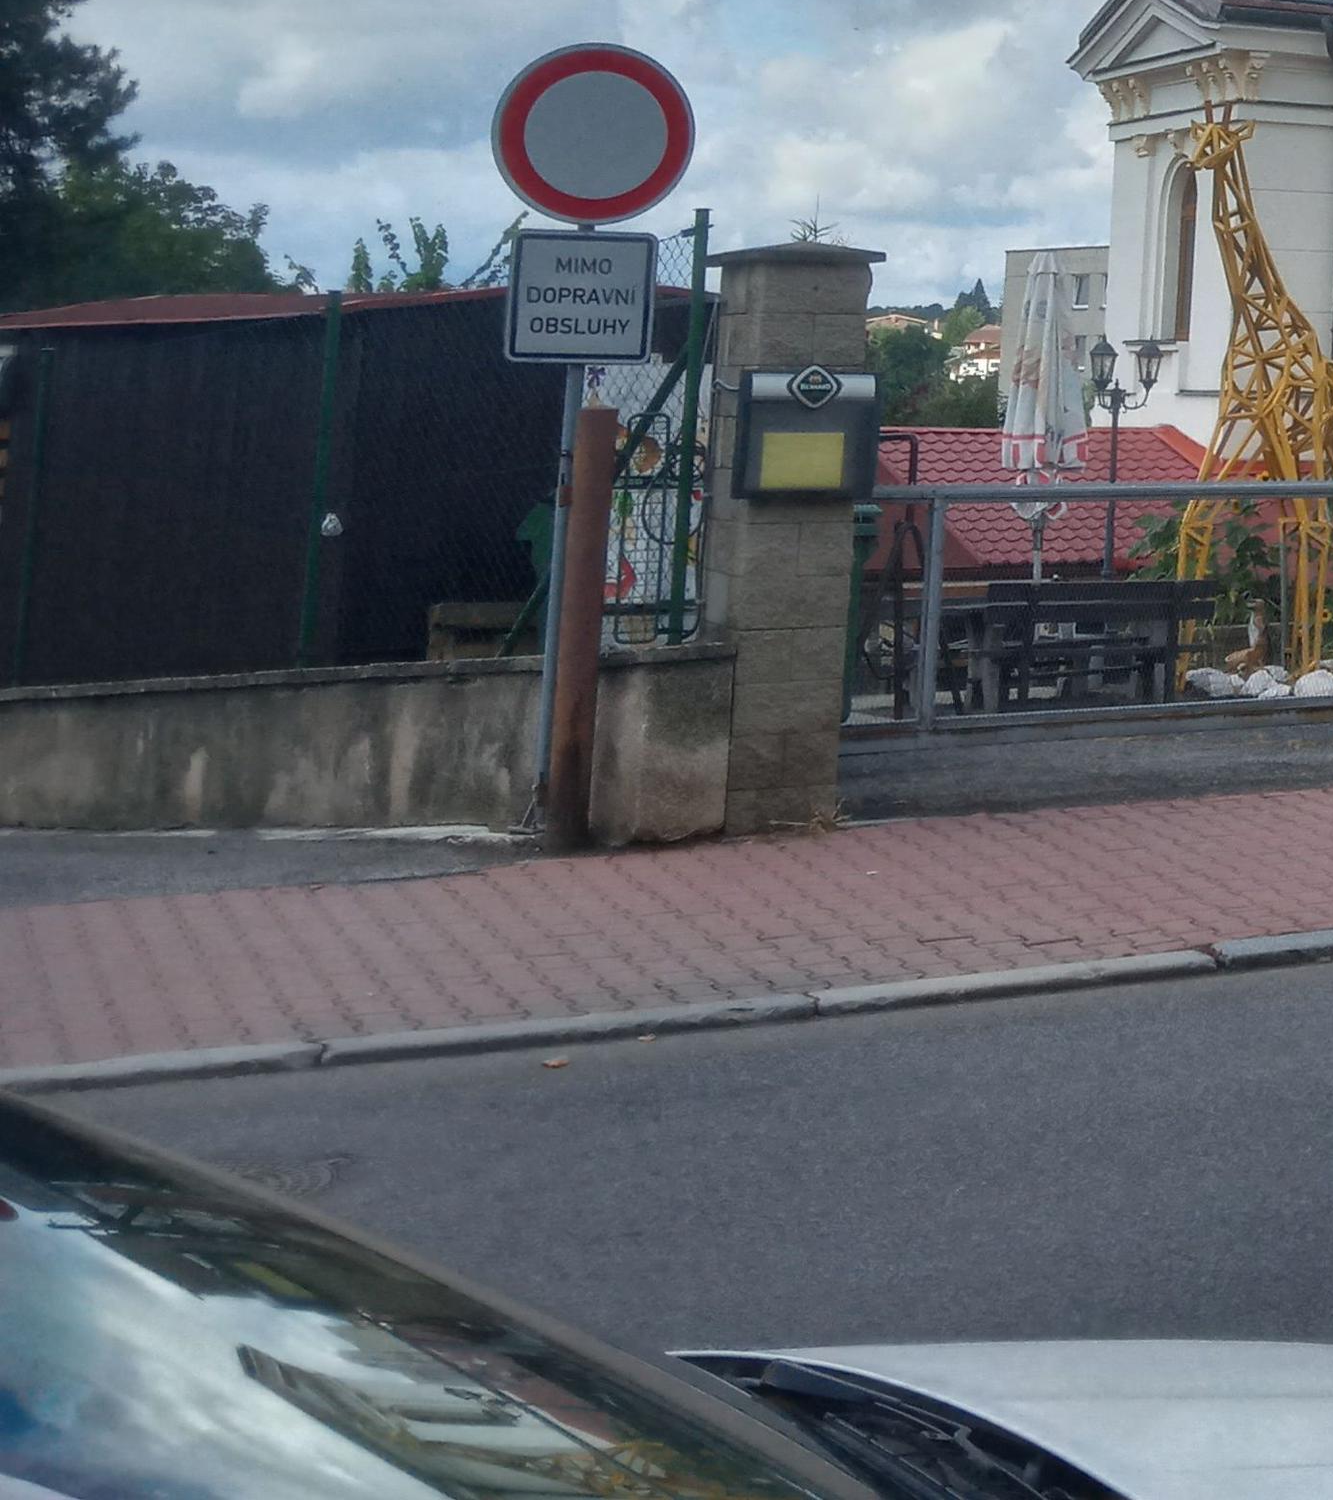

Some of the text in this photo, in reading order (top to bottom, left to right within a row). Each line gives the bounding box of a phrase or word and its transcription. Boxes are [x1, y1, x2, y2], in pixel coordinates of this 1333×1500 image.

[555, 257, 612, 275] MIMO
[526, 284, 636, 305] DOPRAVNÍ
[530, 317, 630, 334] OBSLUHY
